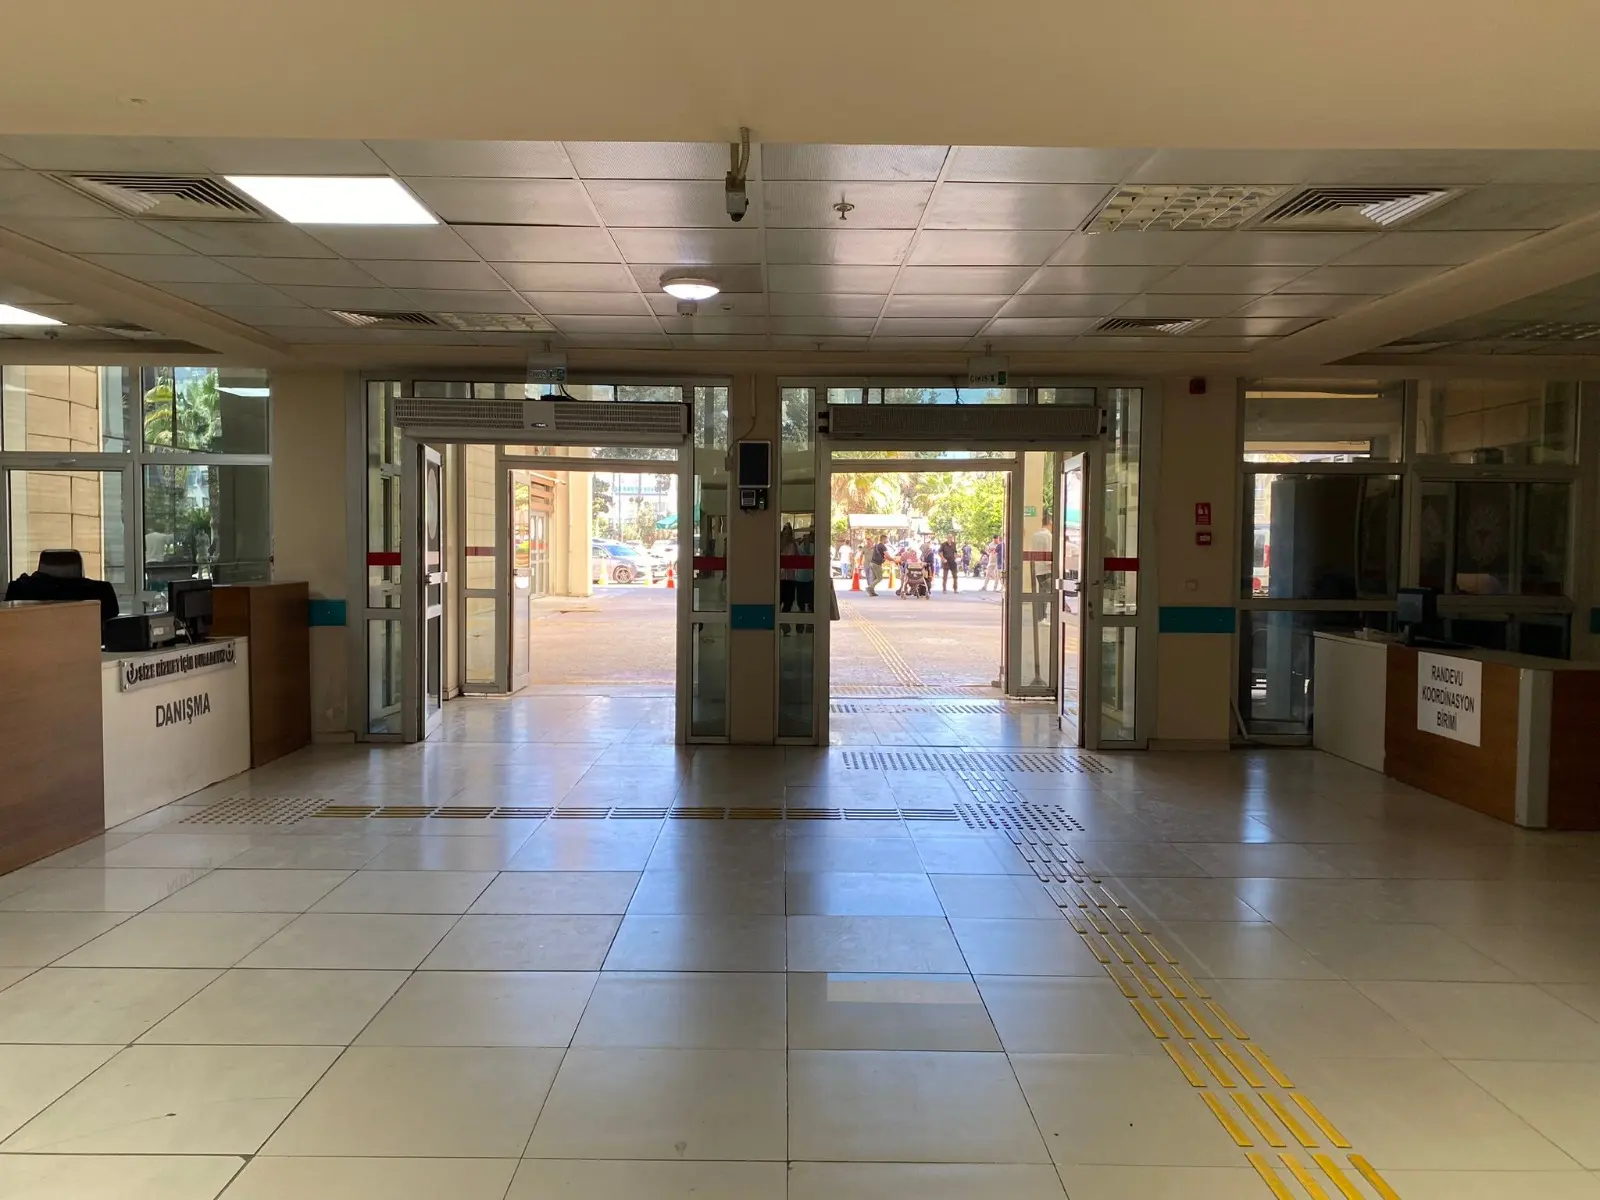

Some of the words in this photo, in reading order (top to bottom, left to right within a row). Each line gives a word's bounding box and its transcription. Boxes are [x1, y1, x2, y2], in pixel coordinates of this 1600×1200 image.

[138, 663, 155, 681] SİZE
[1431, 665, 1464, 686] RANDEVU
[155, 692, 210, 728] DANIŞMA
[1421, 686, 1475, 713] KOORDİNASYON
[1437, 709, 1457, 731] BİRİMİ
